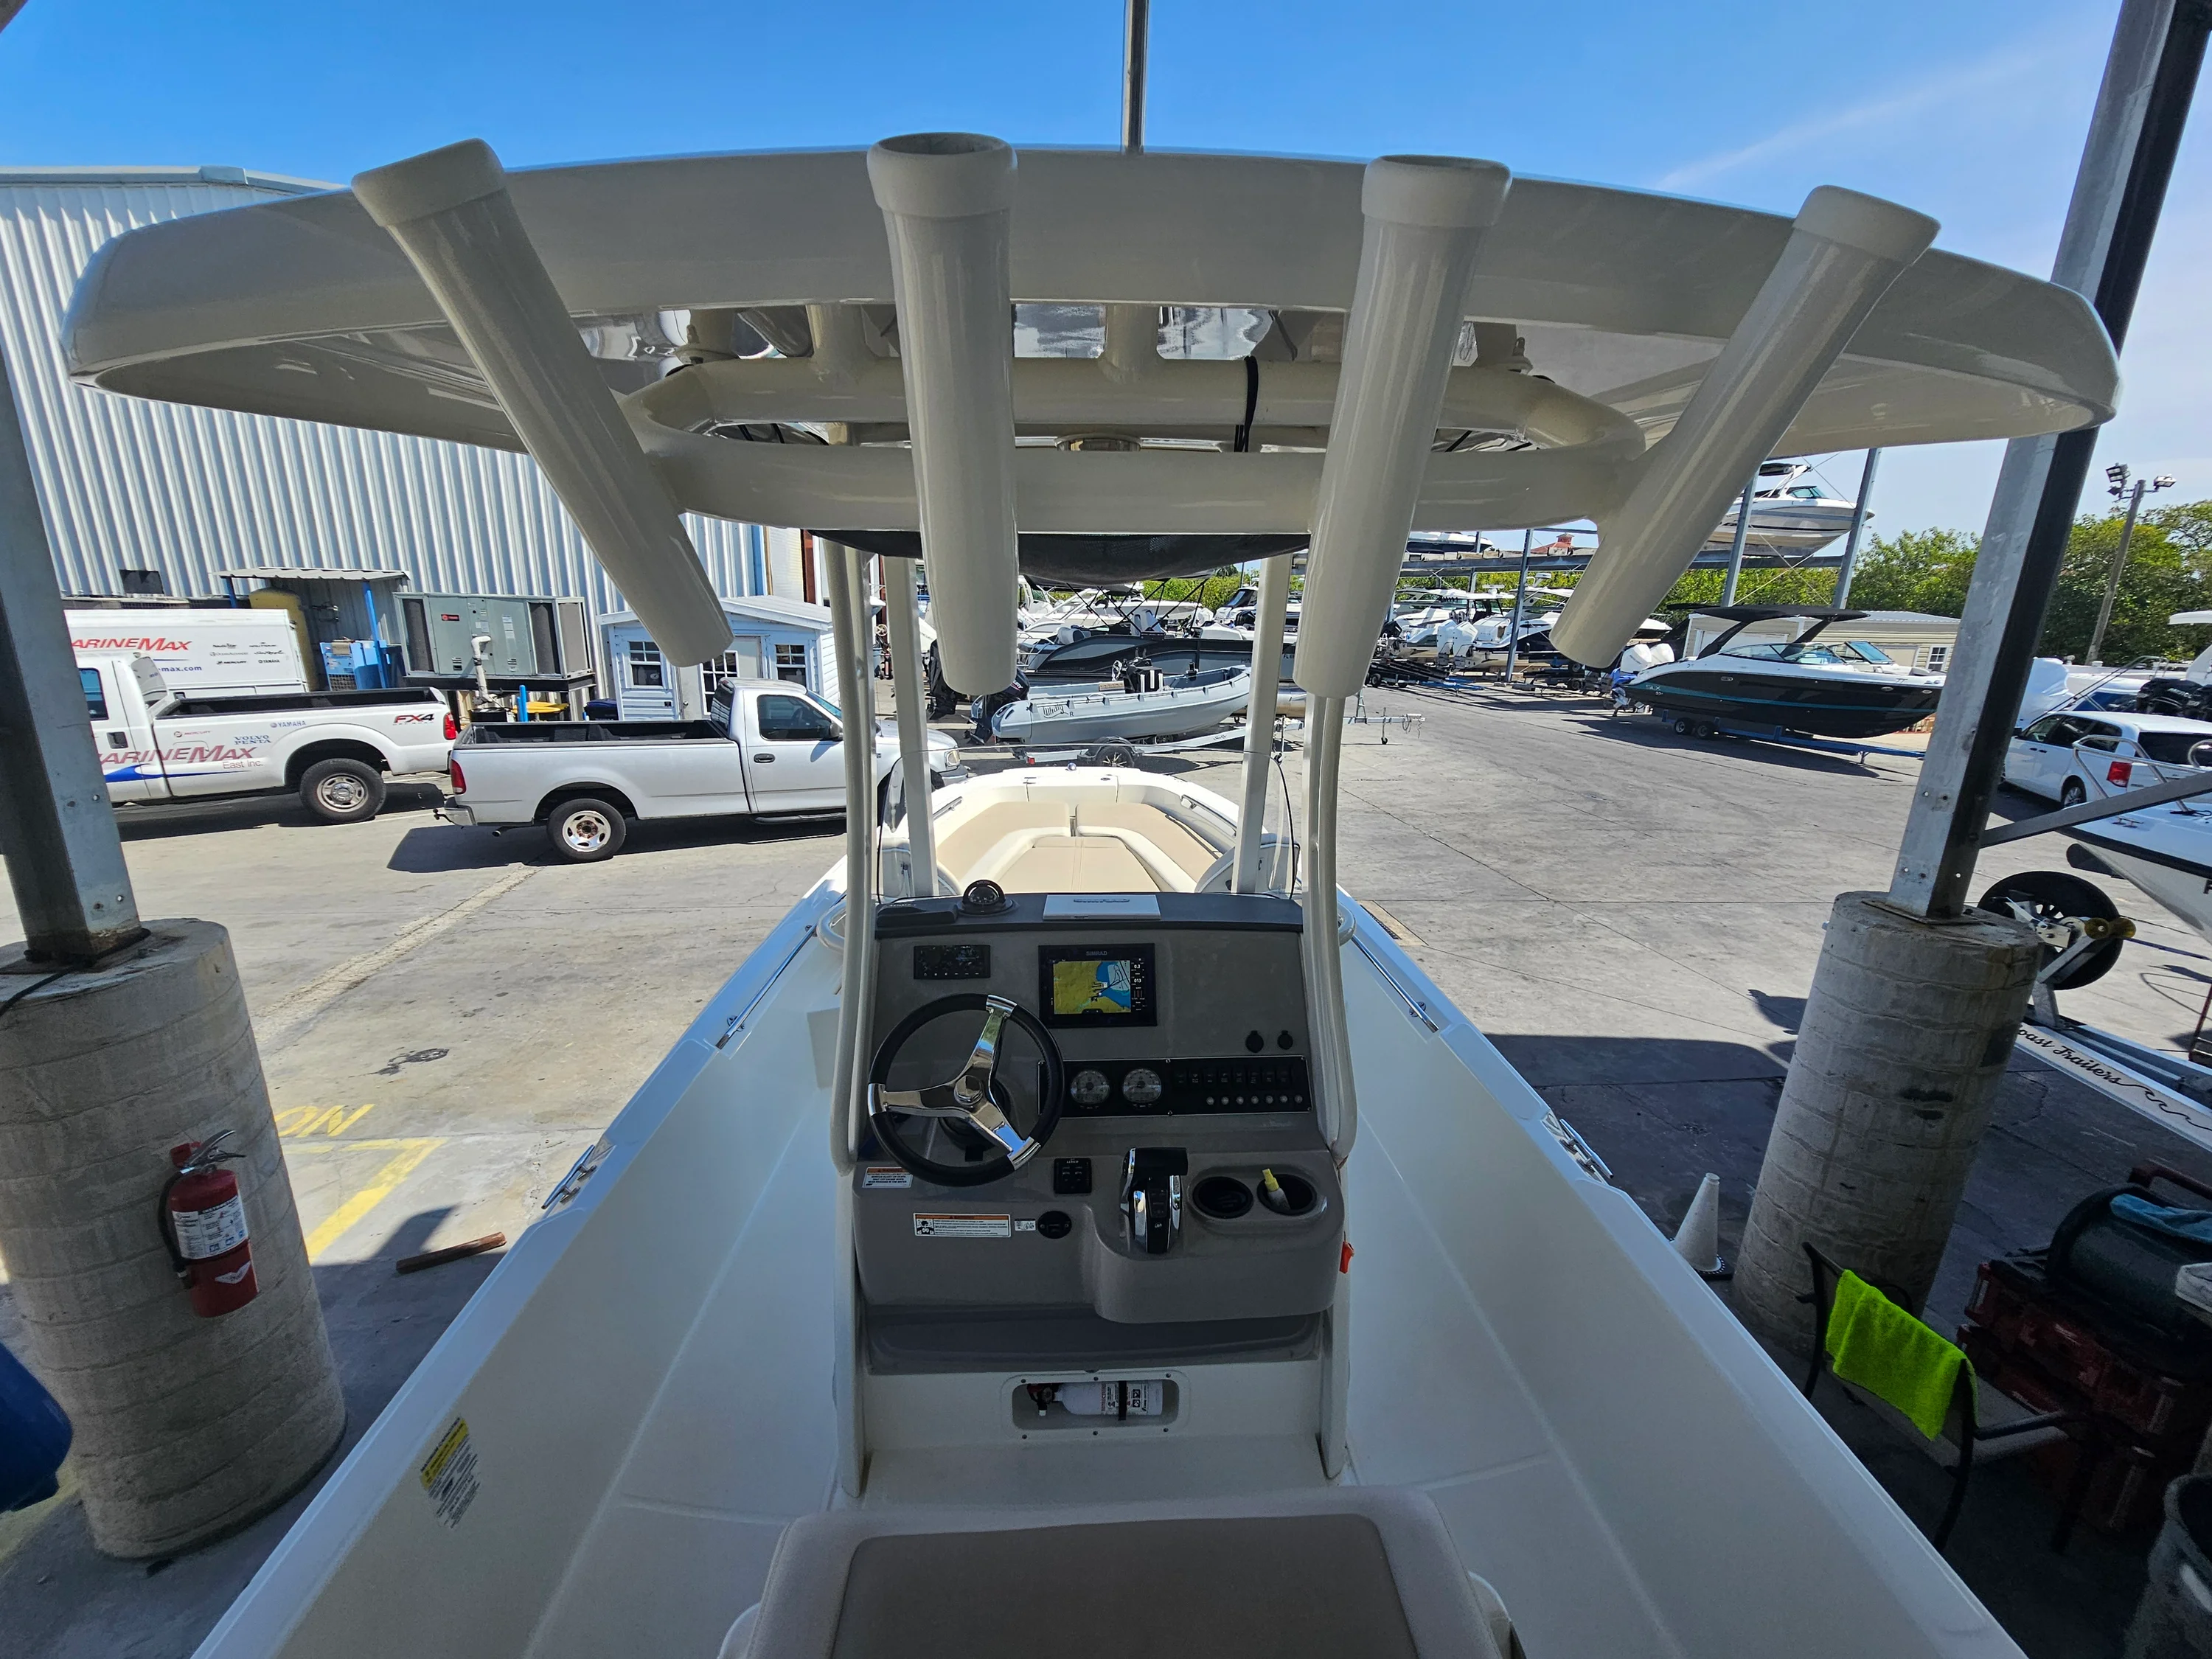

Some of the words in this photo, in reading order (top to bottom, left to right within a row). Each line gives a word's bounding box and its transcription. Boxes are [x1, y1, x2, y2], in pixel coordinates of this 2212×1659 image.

[394, 713, 434, 723] FX4
[277, 720, 307, 728] YAMAHA
[223, 759, 246, 770] East
[247, 759, 264, 768] Inc.
[2018, 1029, 2056, 1048] oast
